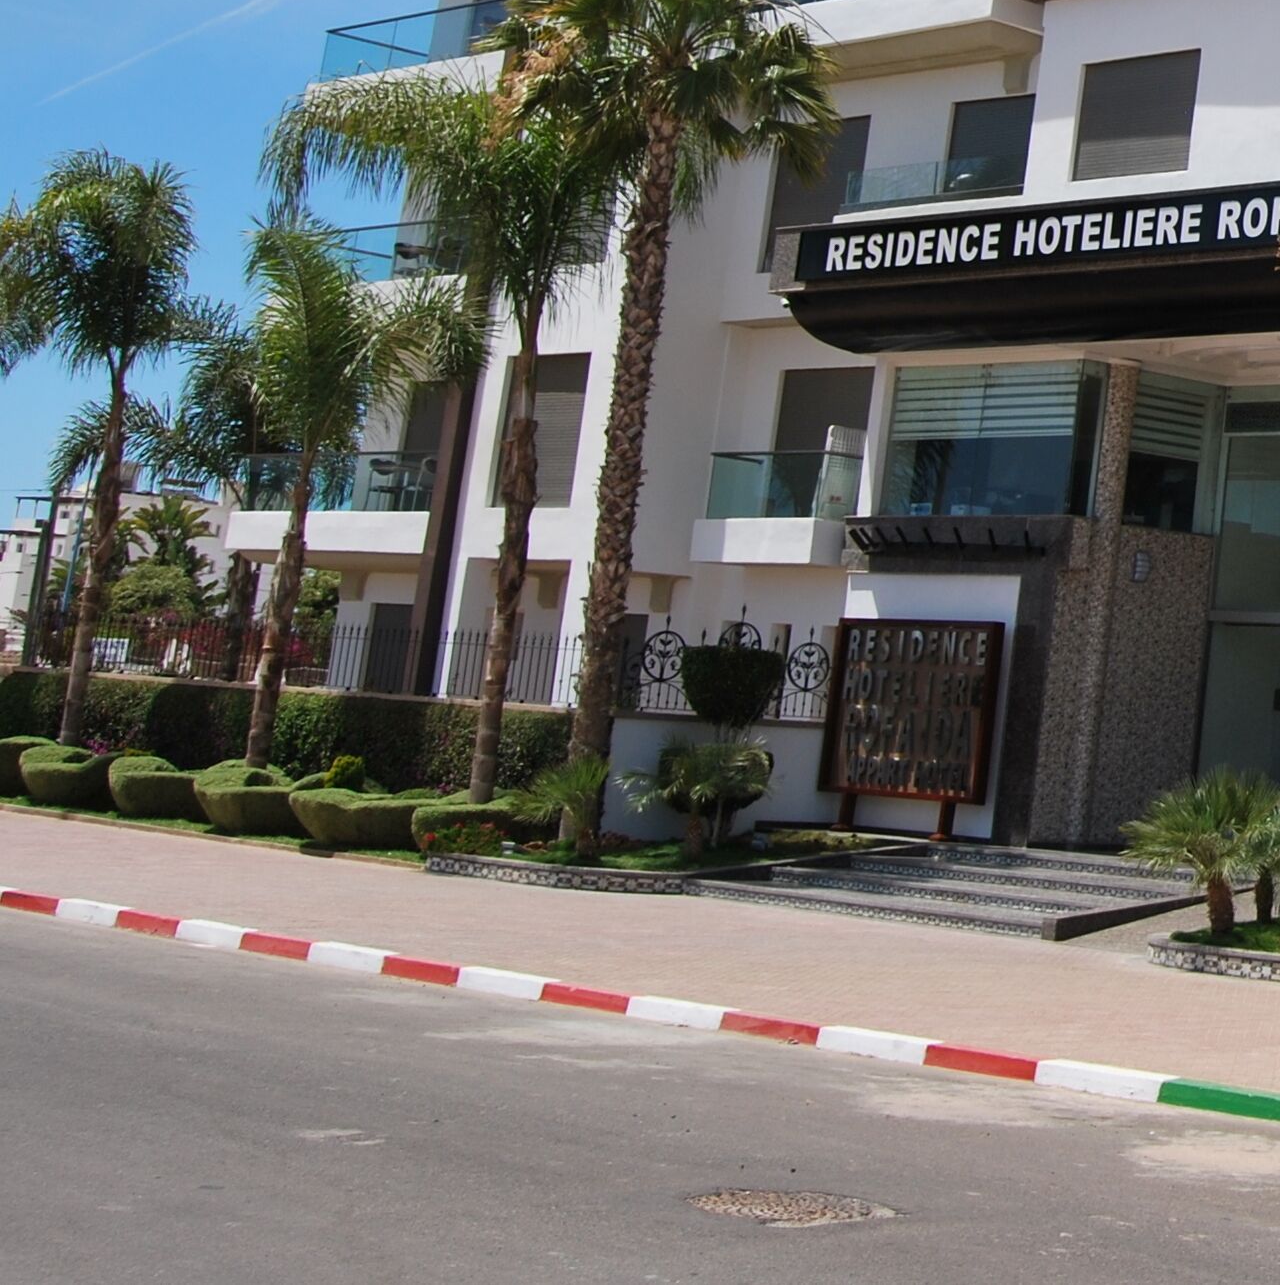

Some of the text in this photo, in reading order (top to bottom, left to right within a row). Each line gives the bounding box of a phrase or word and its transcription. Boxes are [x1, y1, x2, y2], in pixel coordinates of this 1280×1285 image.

[826, 223, 1000, 272] RESIDENCE
[1013, 204, 1203, 257] HOTELIERE
[848, 629, 988, 666] RESIDENCE
[842, 666, 986, 707] HOTELIERE
